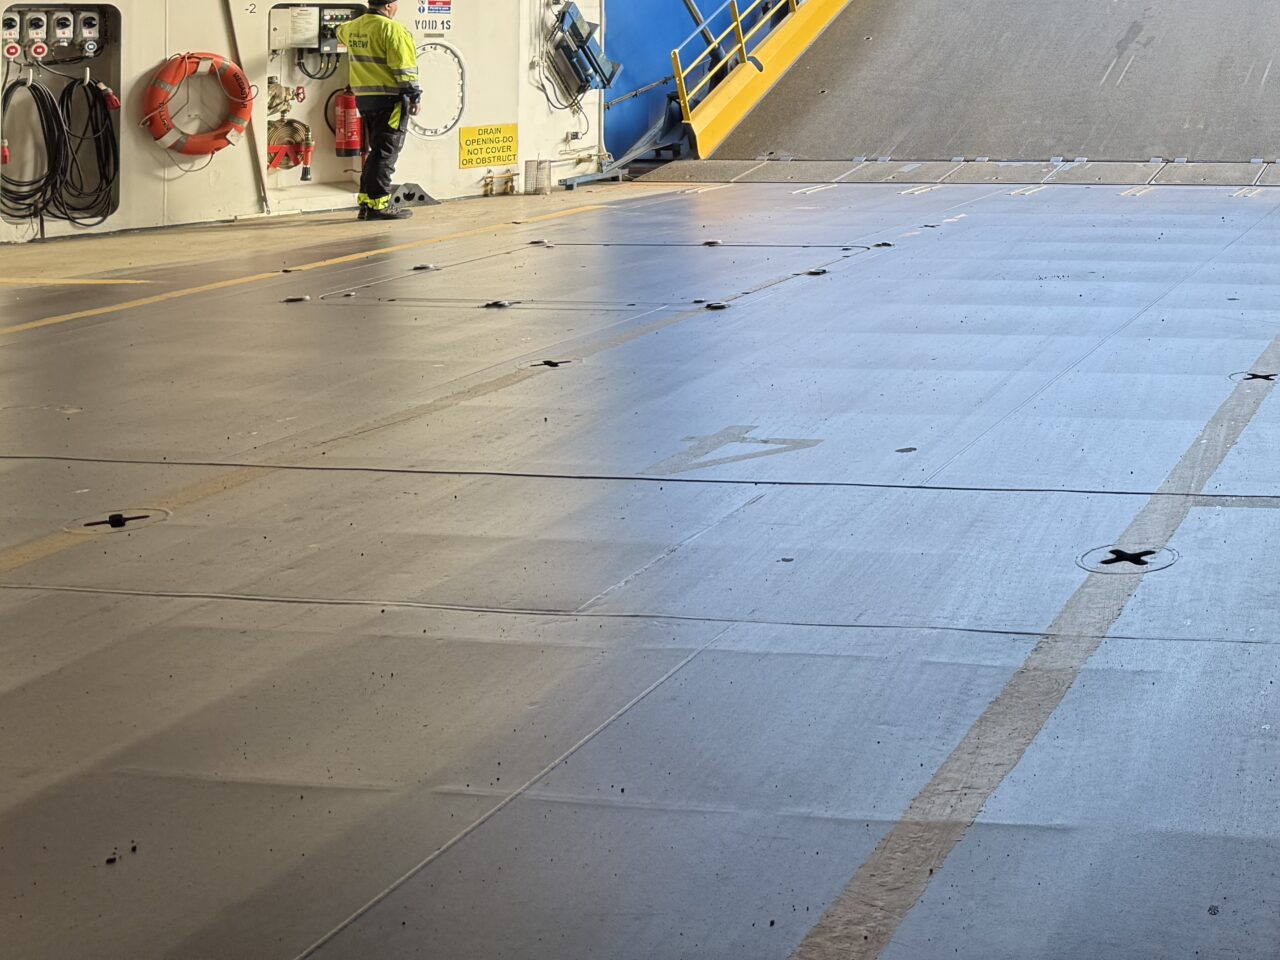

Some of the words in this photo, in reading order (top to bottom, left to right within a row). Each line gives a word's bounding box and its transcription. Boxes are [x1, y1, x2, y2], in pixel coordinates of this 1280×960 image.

[415, 19, 437, 30] VOID
[477, 127, 502, 136] DRAIN
[465, 135, 514, 146] OPENING-DO
[467, 147, 484, 156] NOT
[485, 145, 512, 155] COVER
[461, 158, 474, 166] OR
[475, 153, 517, 165] OBSTRUCT
